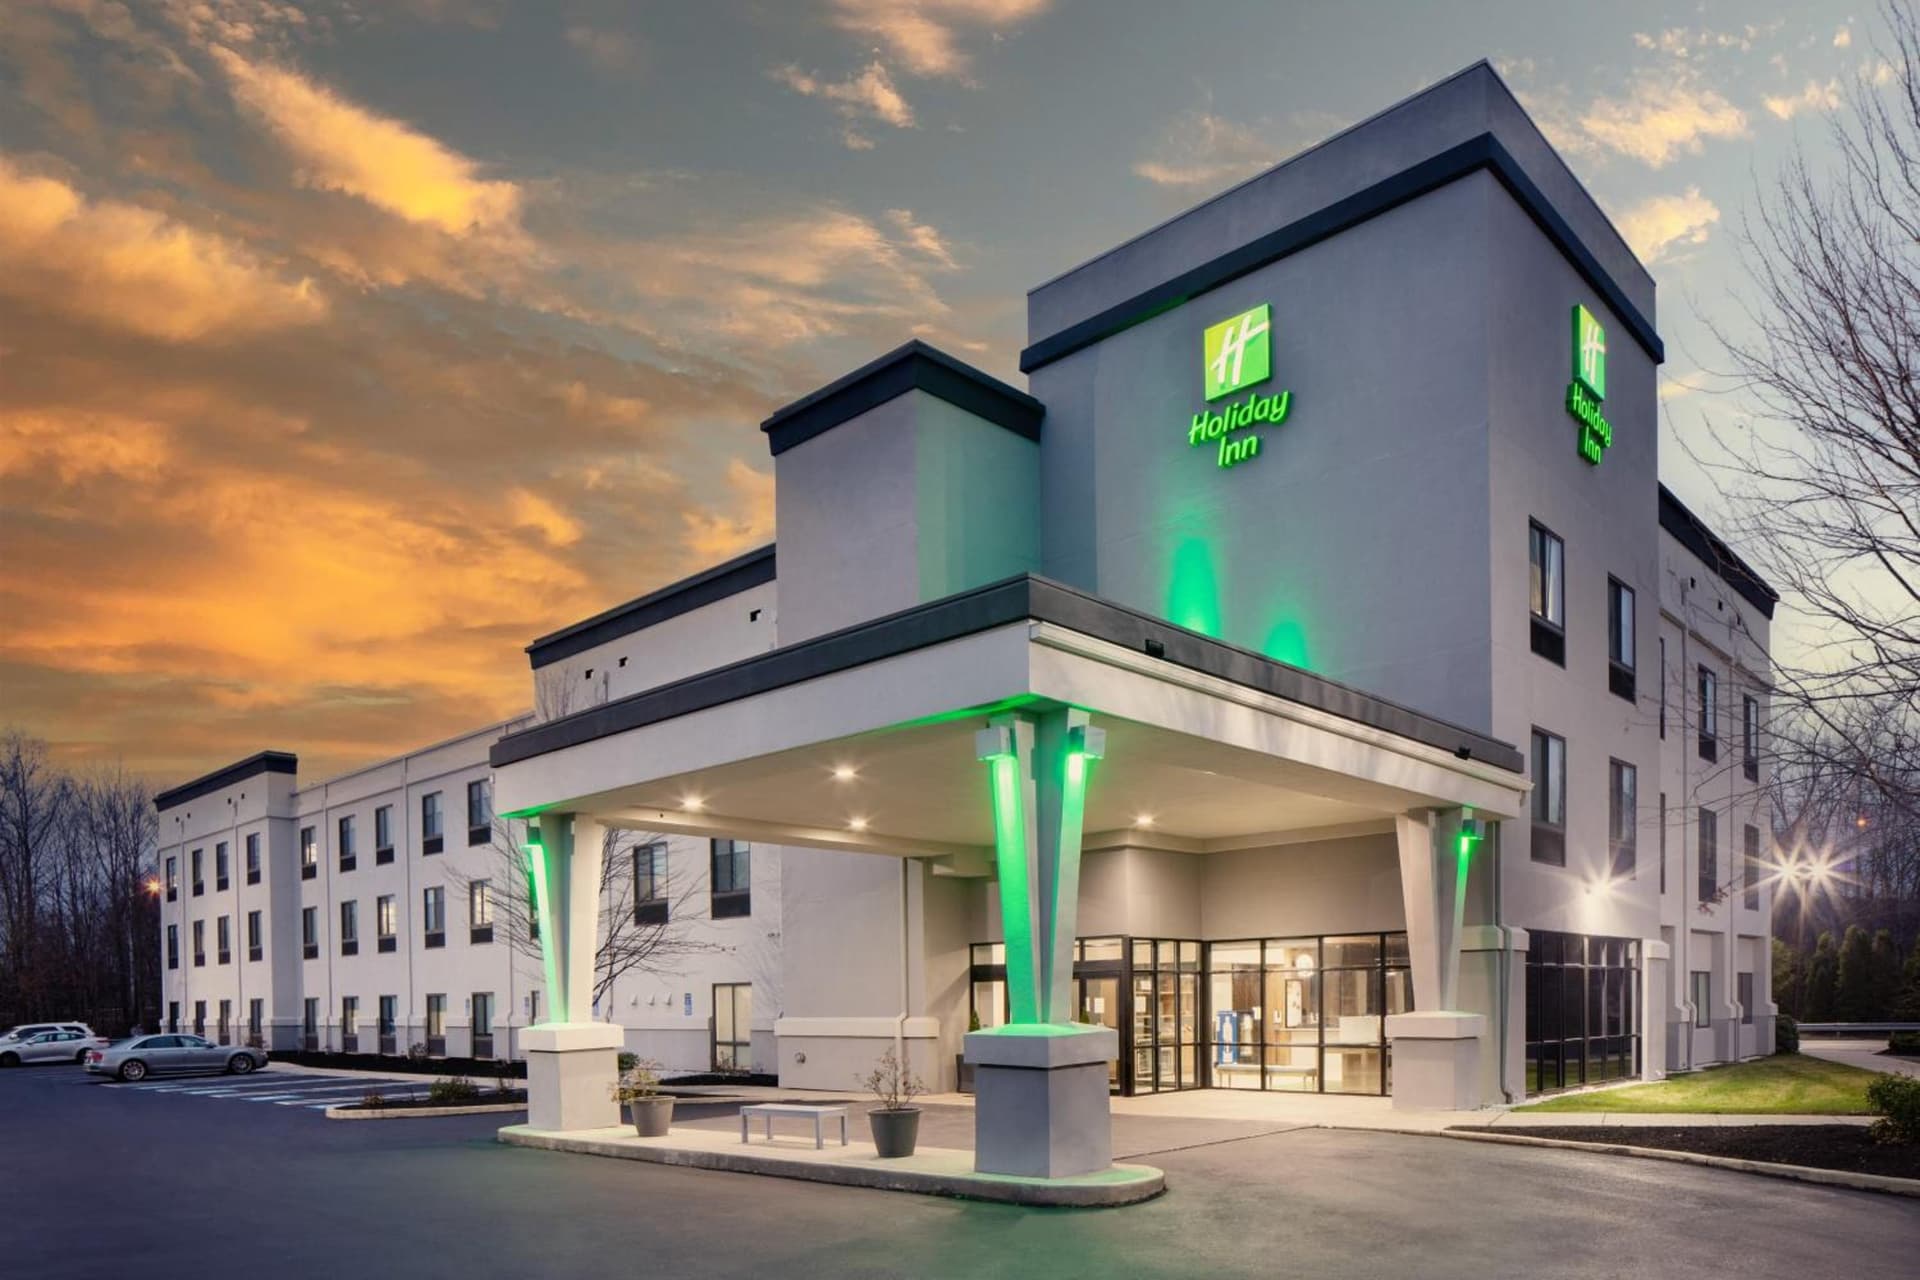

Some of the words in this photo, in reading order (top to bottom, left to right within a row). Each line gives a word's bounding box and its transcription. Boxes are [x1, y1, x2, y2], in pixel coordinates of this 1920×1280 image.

[1188, 390, 1289, 444] Holiday
[1573, 382, 1612, 448] Holiday
[1217, 435, 1258, 467] Inn
[1584, 426, 1601, 464] Inn
